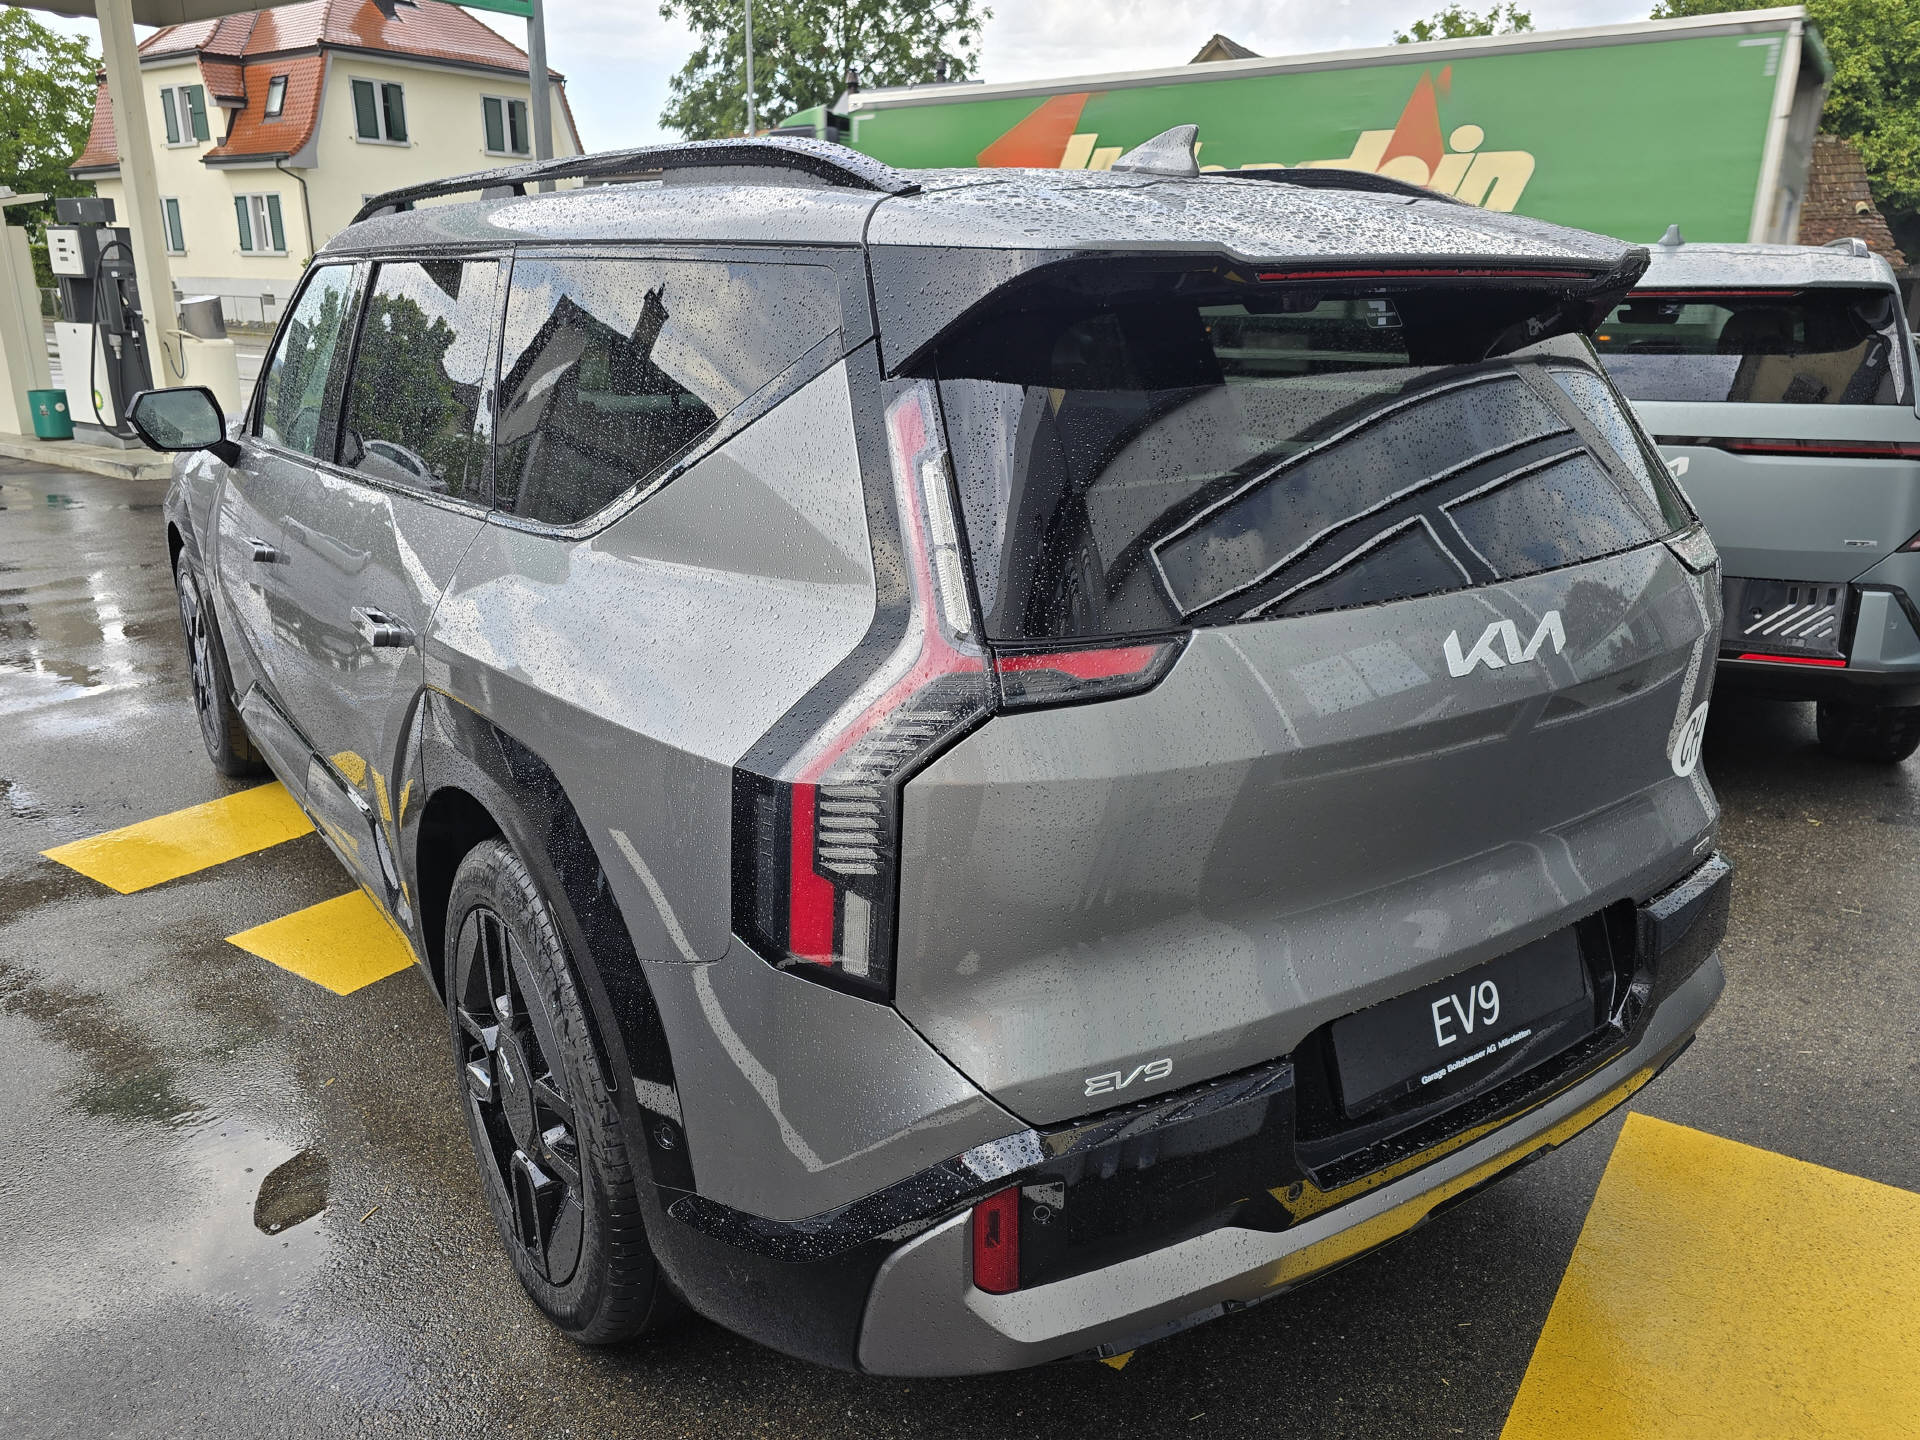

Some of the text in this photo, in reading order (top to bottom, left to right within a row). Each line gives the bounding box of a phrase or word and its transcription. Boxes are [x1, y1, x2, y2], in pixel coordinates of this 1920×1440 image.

[76, 201, 82, 215] 1
[1443, 610, 1566, 678] KIA
[1680, 707, 1707, 767] CH
[1431, 980, 1500, 1047] EV9
[1084, 1058, 1173, 1097] EV9
[1421, 1068, 1447, 1085] Garage
[1447, 1049, 1486, 1073] Boltshauser
[1486, 1043, 1497, 1055] AG
